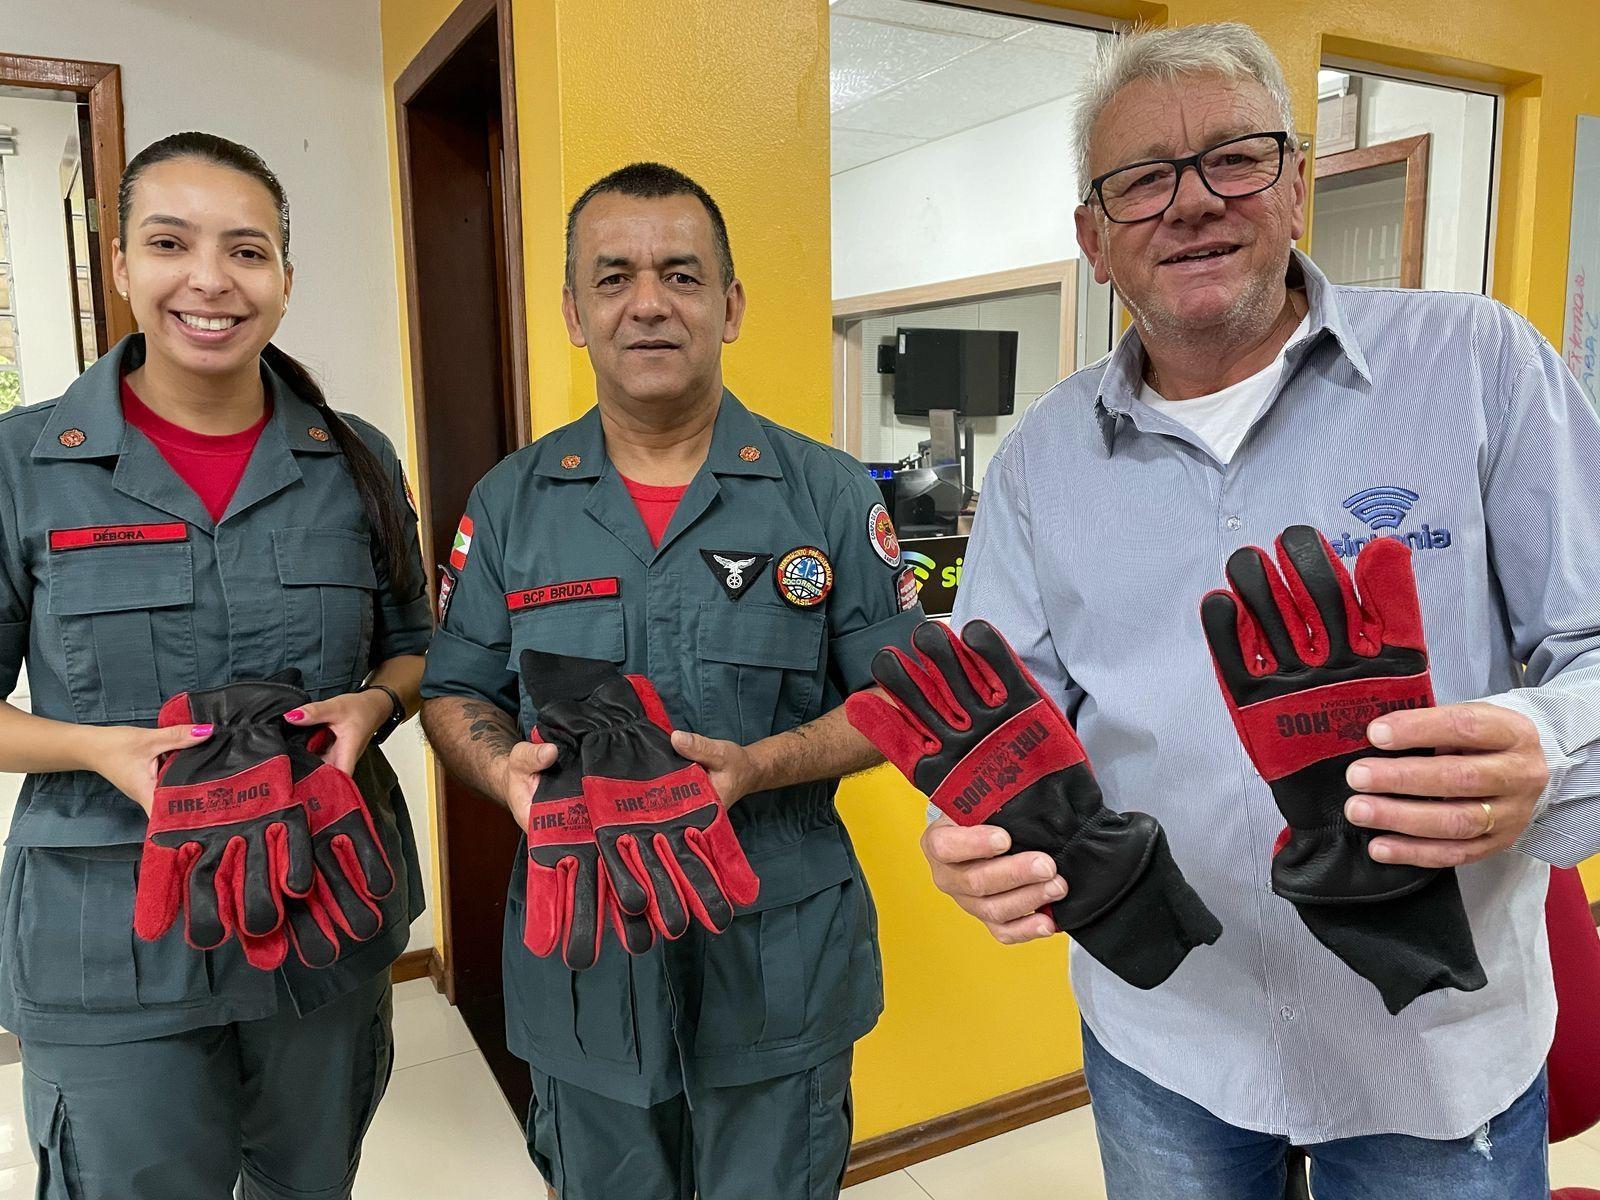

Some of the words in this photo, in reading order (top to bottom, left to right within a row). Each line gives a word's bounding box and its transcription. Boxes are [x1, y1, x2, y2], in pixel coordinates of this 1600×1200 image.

[93, 529, 145, 542] DÉBORA
[1329, 523, 1451, 558] sinnia
[523, 590, 544, 605] BCP
[551, 583, 594, 599] BRUDA
[781, 578, 823, 596] SOCORRISTA
[786, 592, 813, 606] BRASIL
[1275, 711, 1331, 737] HOG
[1008, 720, 1050, 760] FIRE
[168, 797, 205, 815] FIRE
[236, 783, 271, 804] HOG
[614, 797, 646, 812] FIRE
[670, 782, 702, 801] HOG
[953, 774, 992, 815] HOG
[532, 812, 566, 831] FIRE
